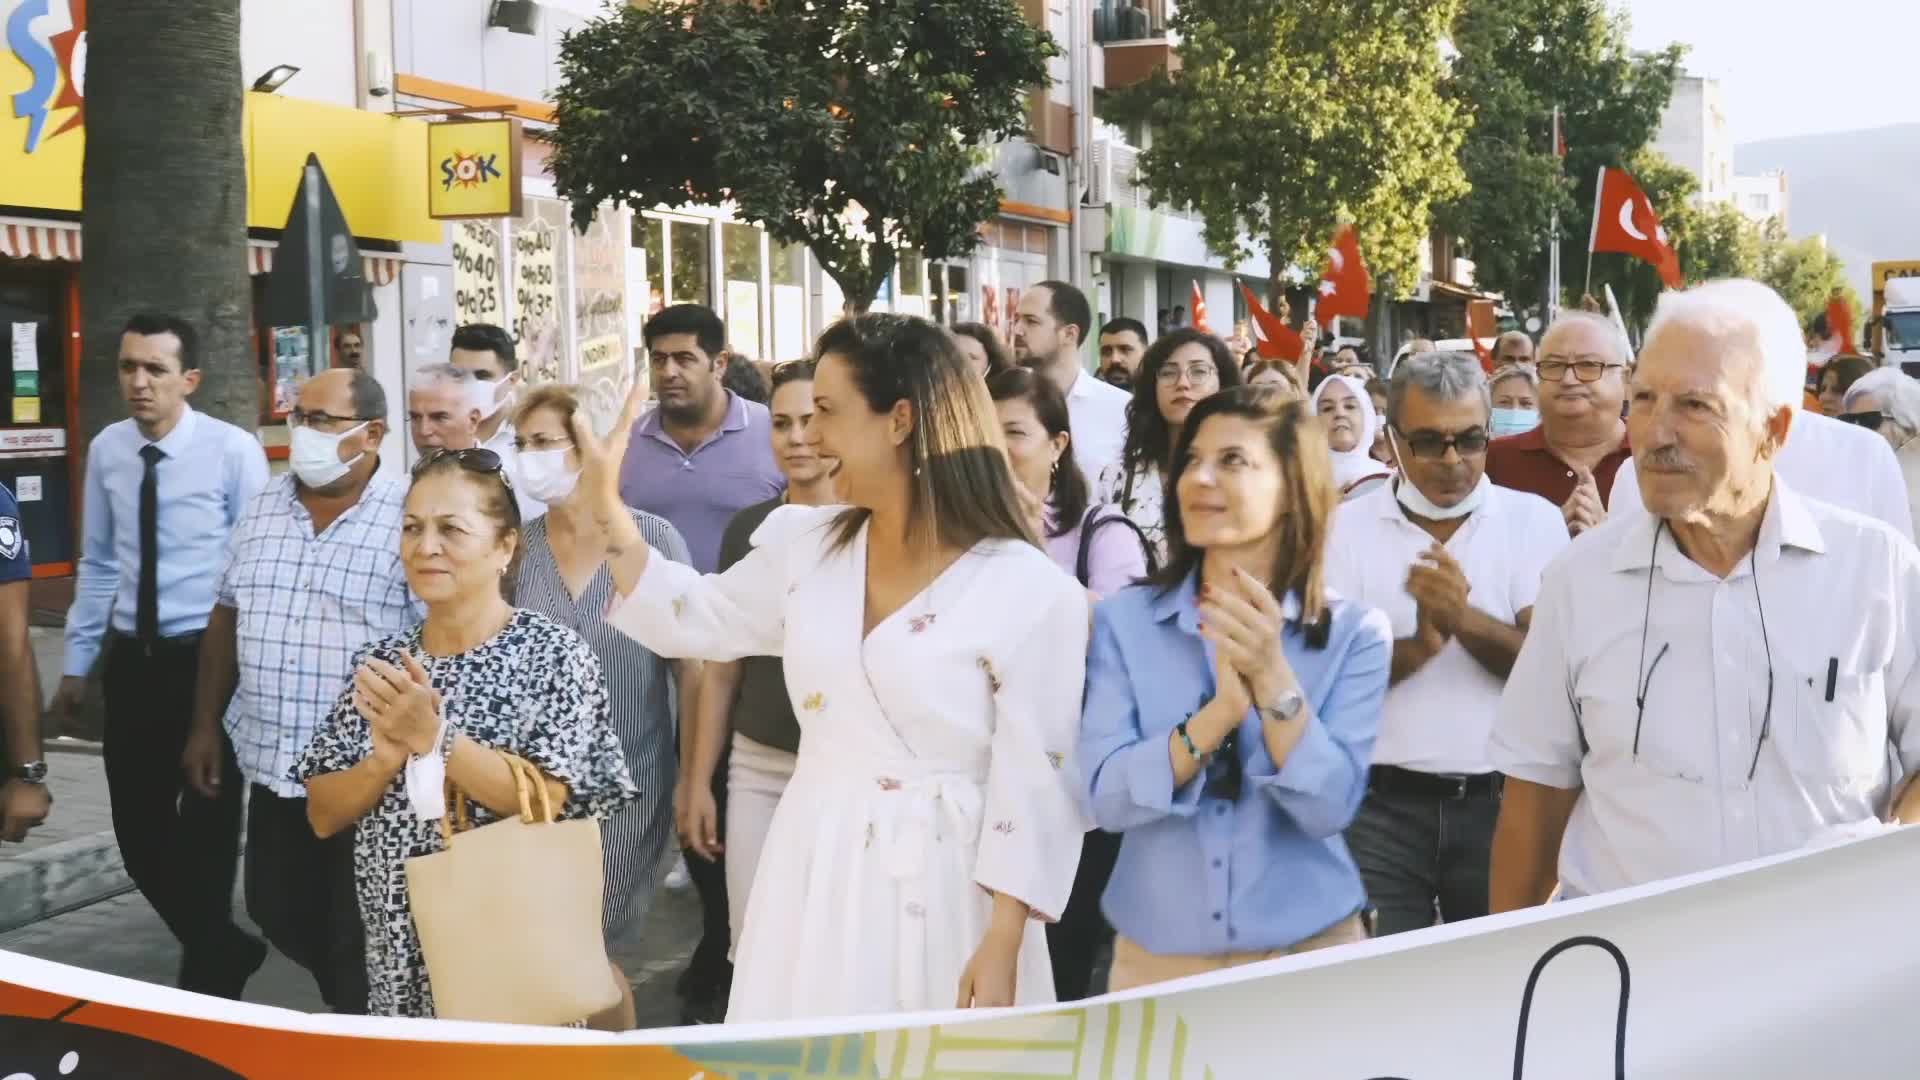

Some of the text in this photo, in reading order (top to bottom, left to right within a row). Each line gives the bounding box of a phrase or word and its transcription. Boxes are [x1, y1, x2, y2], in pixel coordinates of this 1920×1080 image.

[6, 0, 87, 154] Ş
[441, 153, 501, 192] ŞOK
[516, 231, 552, 256] %40
[453, 243, 495, 282] %40
[521, 265, 553, 285] %50
[456, 287, 497, 316] %25
